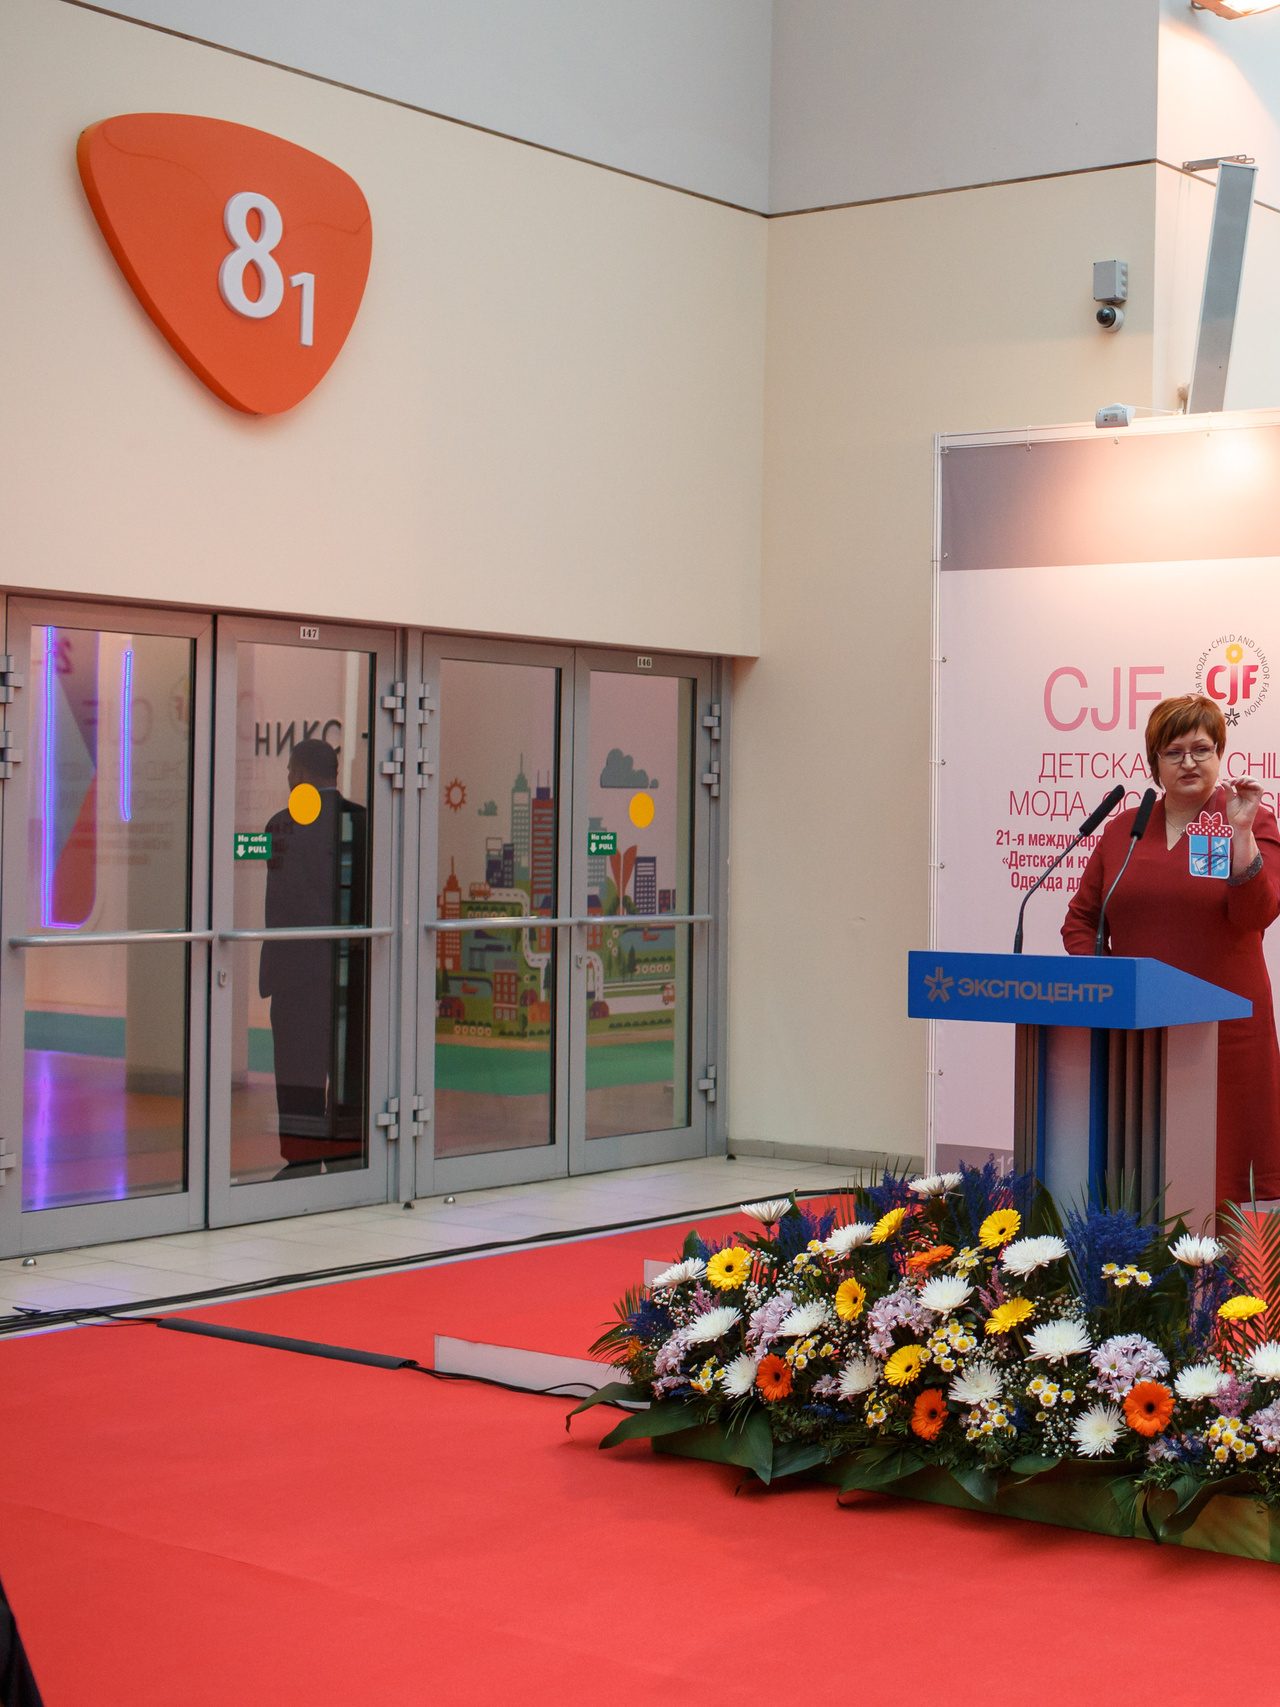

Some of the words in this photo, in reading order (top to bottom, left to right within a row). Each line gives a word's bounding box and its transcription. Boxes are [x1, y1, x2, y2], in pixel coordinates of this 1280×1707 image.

[301, 628, 318, 638] 147
[1211, 634, 1236, 649] CHILD
[1237, 635, 1255, 648] AND
[1254, 647, 1270, 680] JUNIOR
[1043, 666, 1165, 732] CJF
[1243, 682, 1270, 717] FASHION
[1038, 752, 1150, 783] ДЕТСКА
[996, 829, 1025, 846] 21-я
[1066, 855, 1074, 868] и
[957, 977, 1114, 1003] ЭКСПОЦЕНТР
